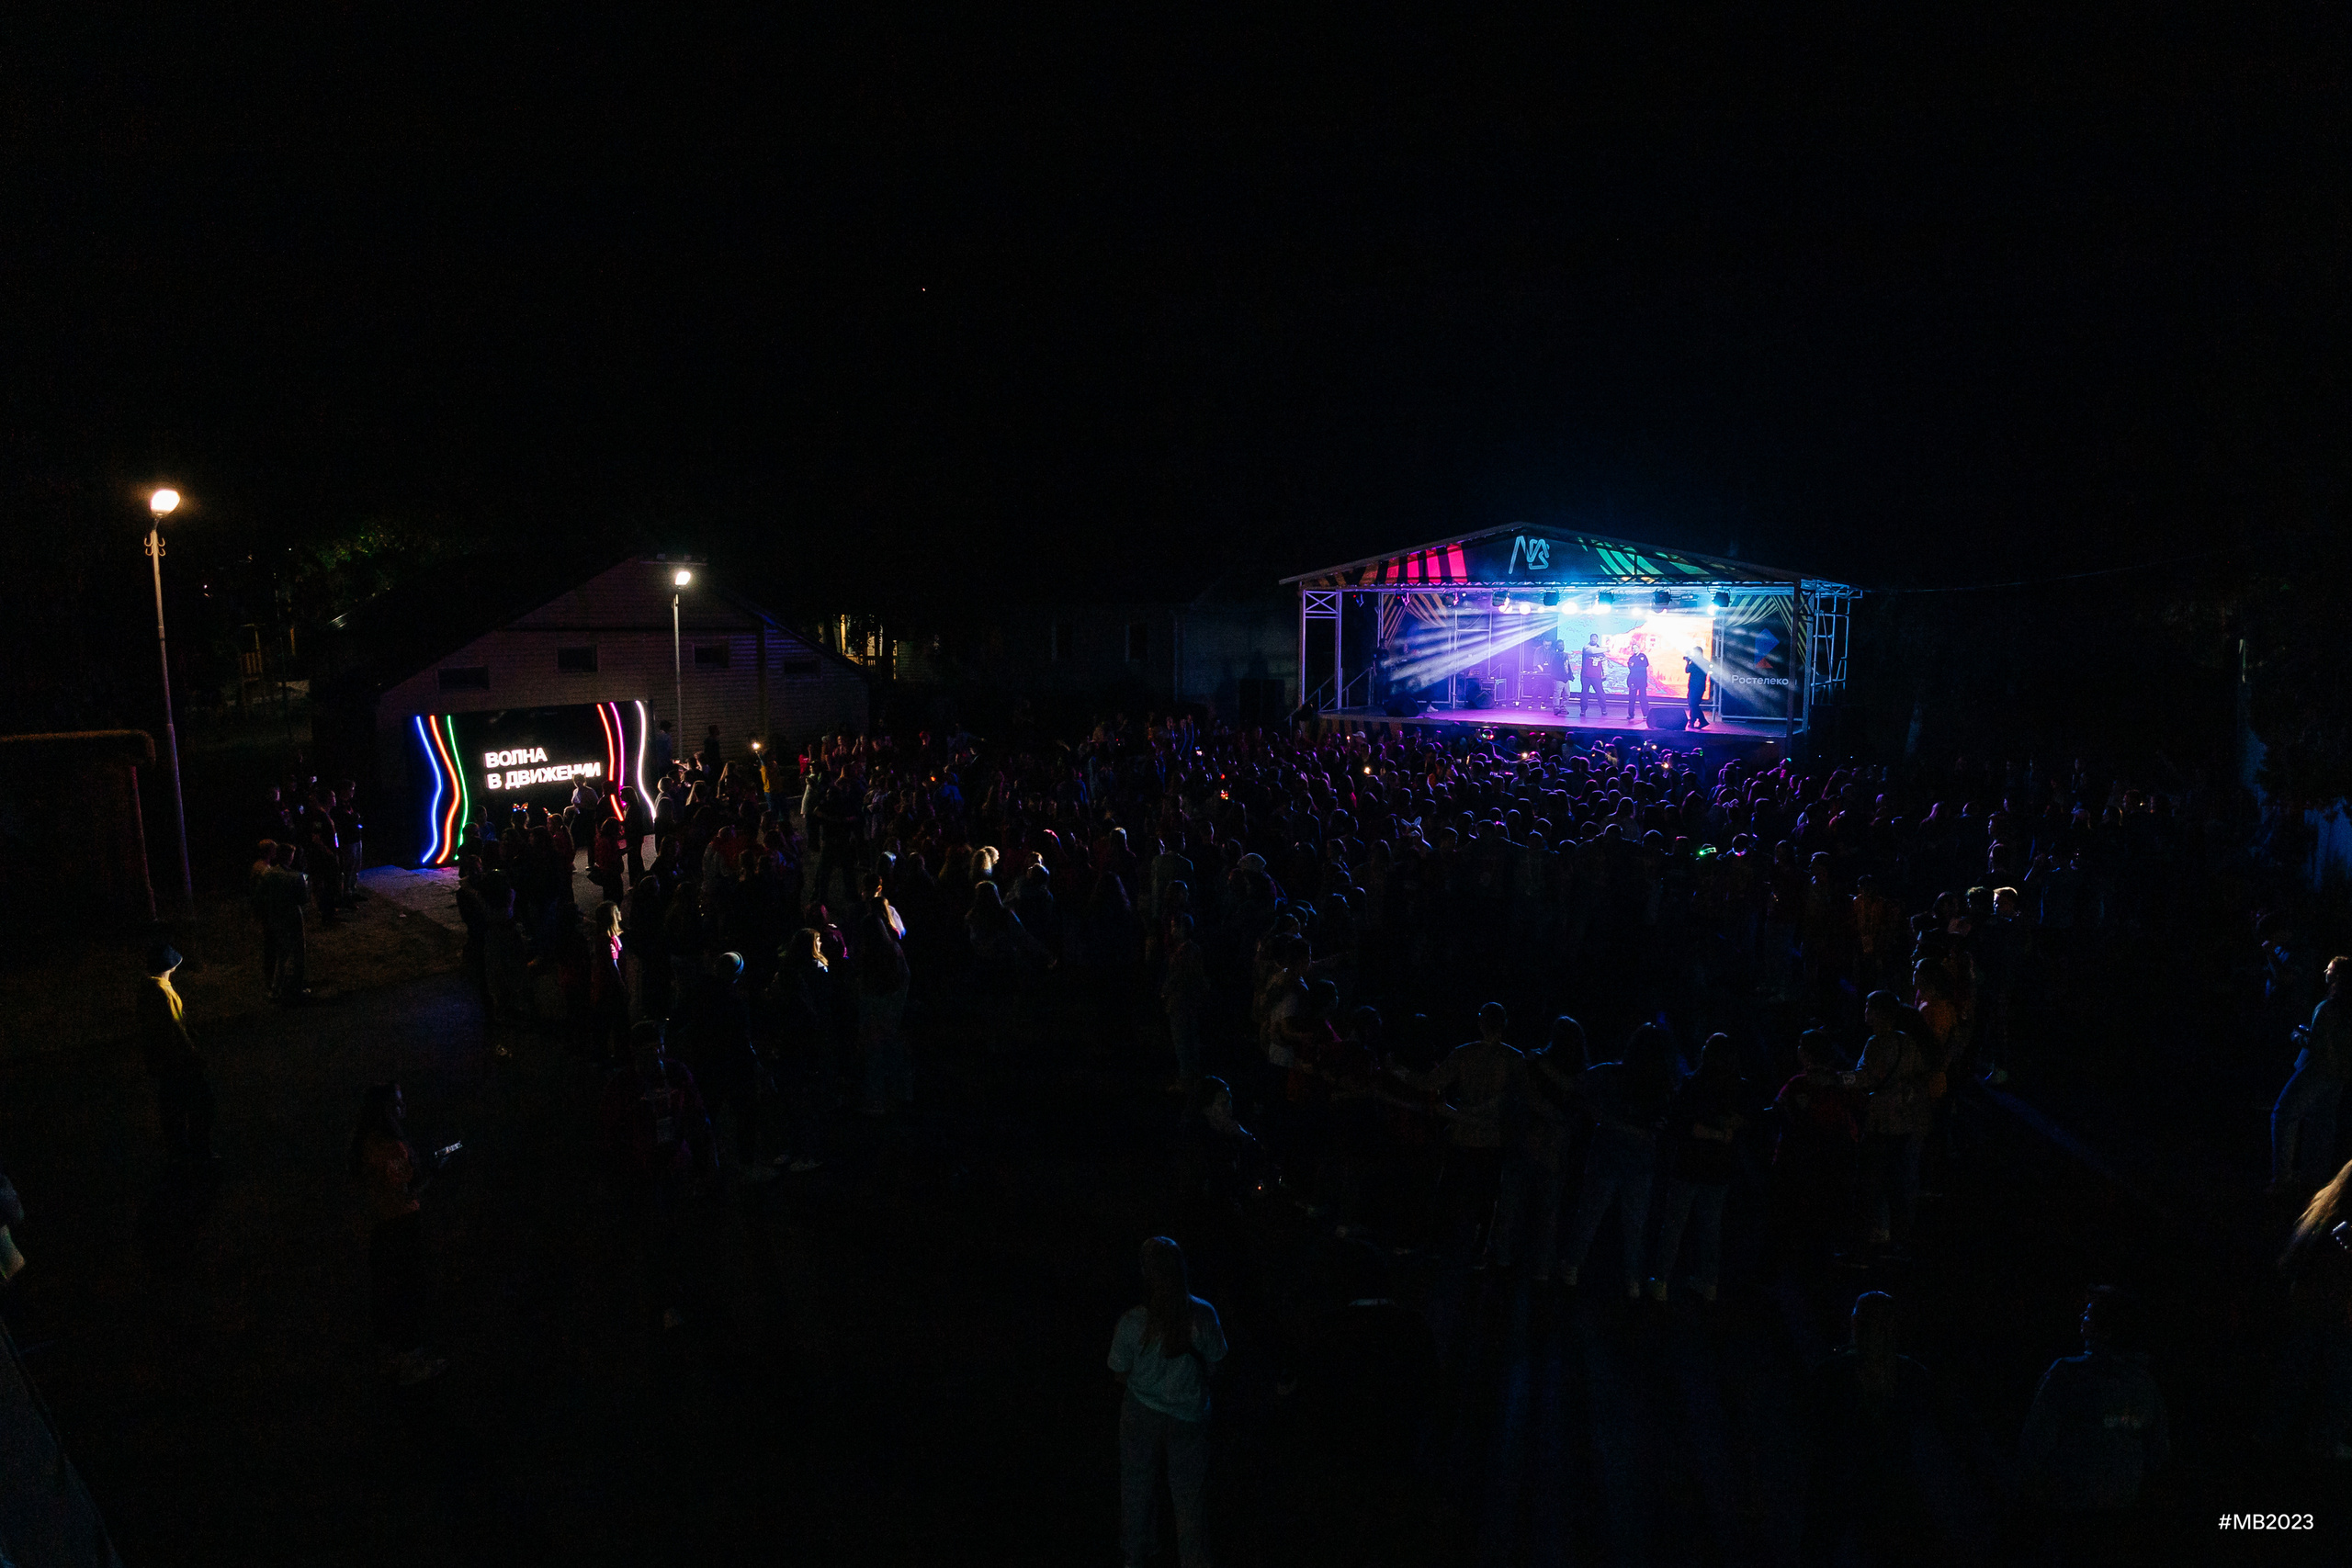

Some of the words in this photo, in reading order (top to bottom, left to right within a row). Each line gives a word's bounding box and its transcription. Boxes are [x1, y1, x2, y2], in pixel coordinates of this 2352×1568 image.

[1731, 674, 1798, 686] Ростелеко
[484, 747, 548, 769] ВОЛНА
[486, 773, 503, 789] В
